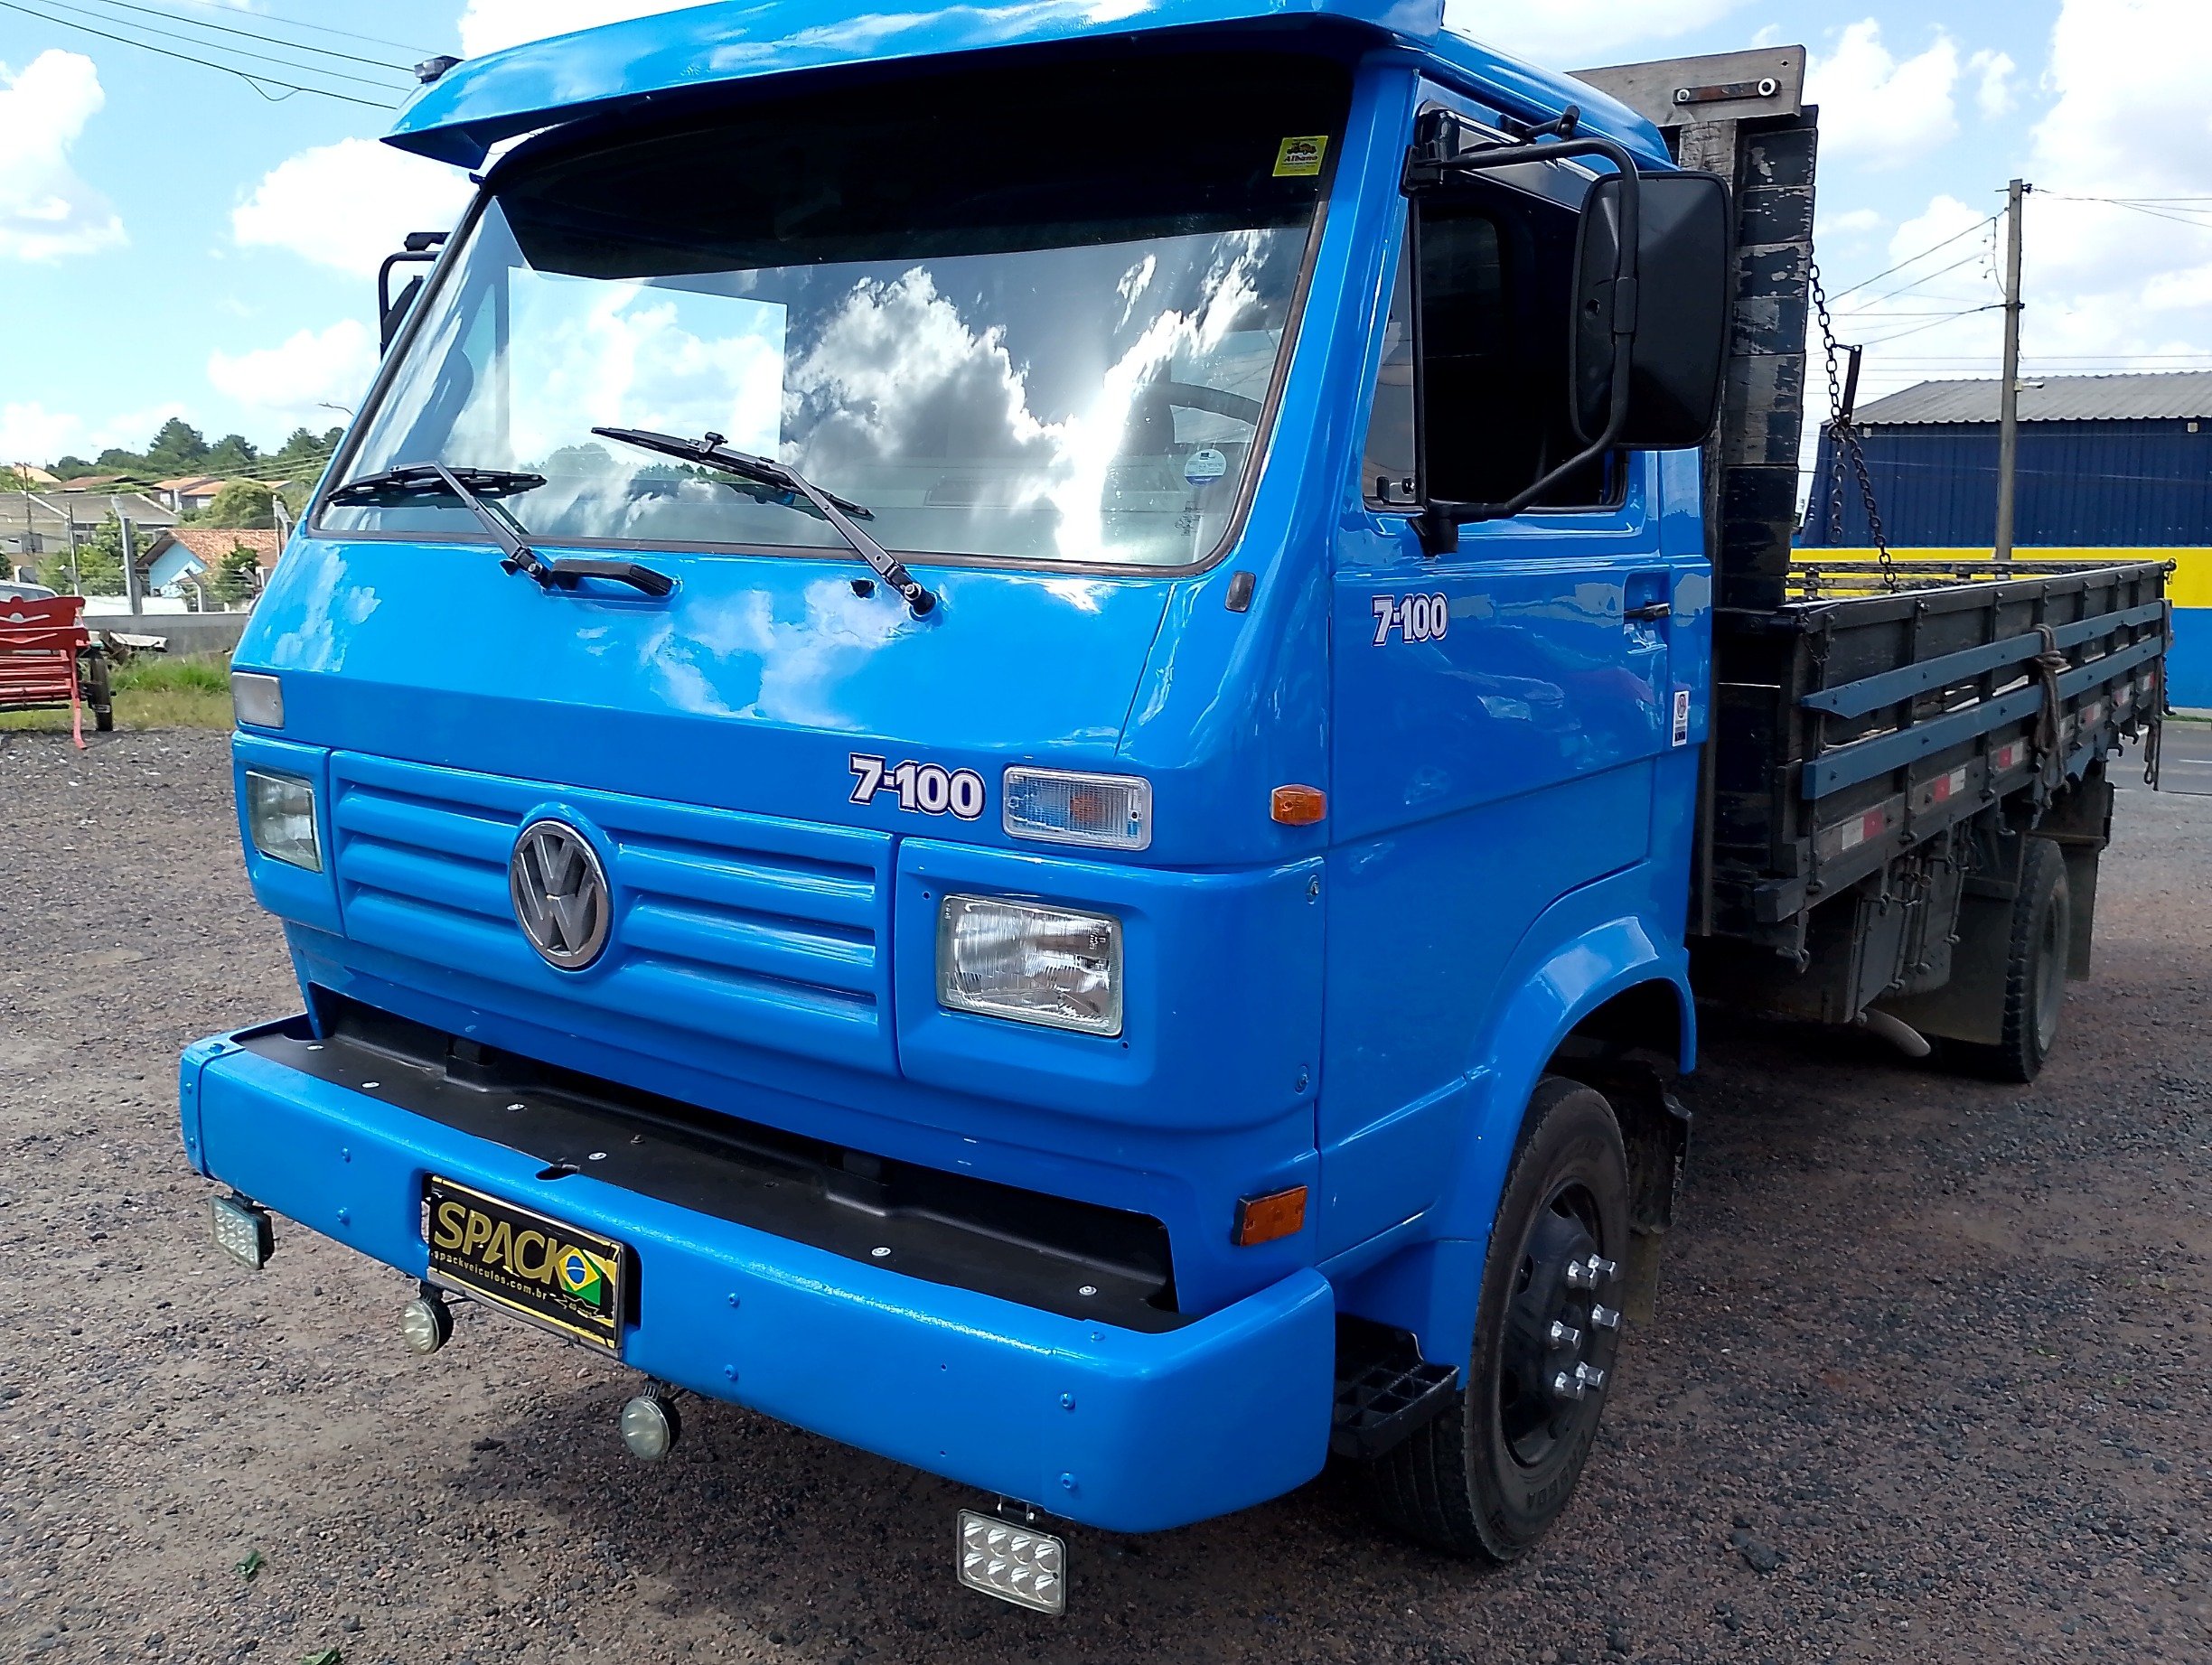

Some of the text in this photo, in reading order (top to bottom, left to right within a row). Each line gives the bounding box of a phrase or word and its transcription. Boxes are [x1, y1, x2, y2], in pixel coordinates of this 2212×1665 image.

[1372, 593, 1448, 647] 7-100
[848, 752, 986, 821] 7-100
[434, 1202, 567, 1291] SPACK
